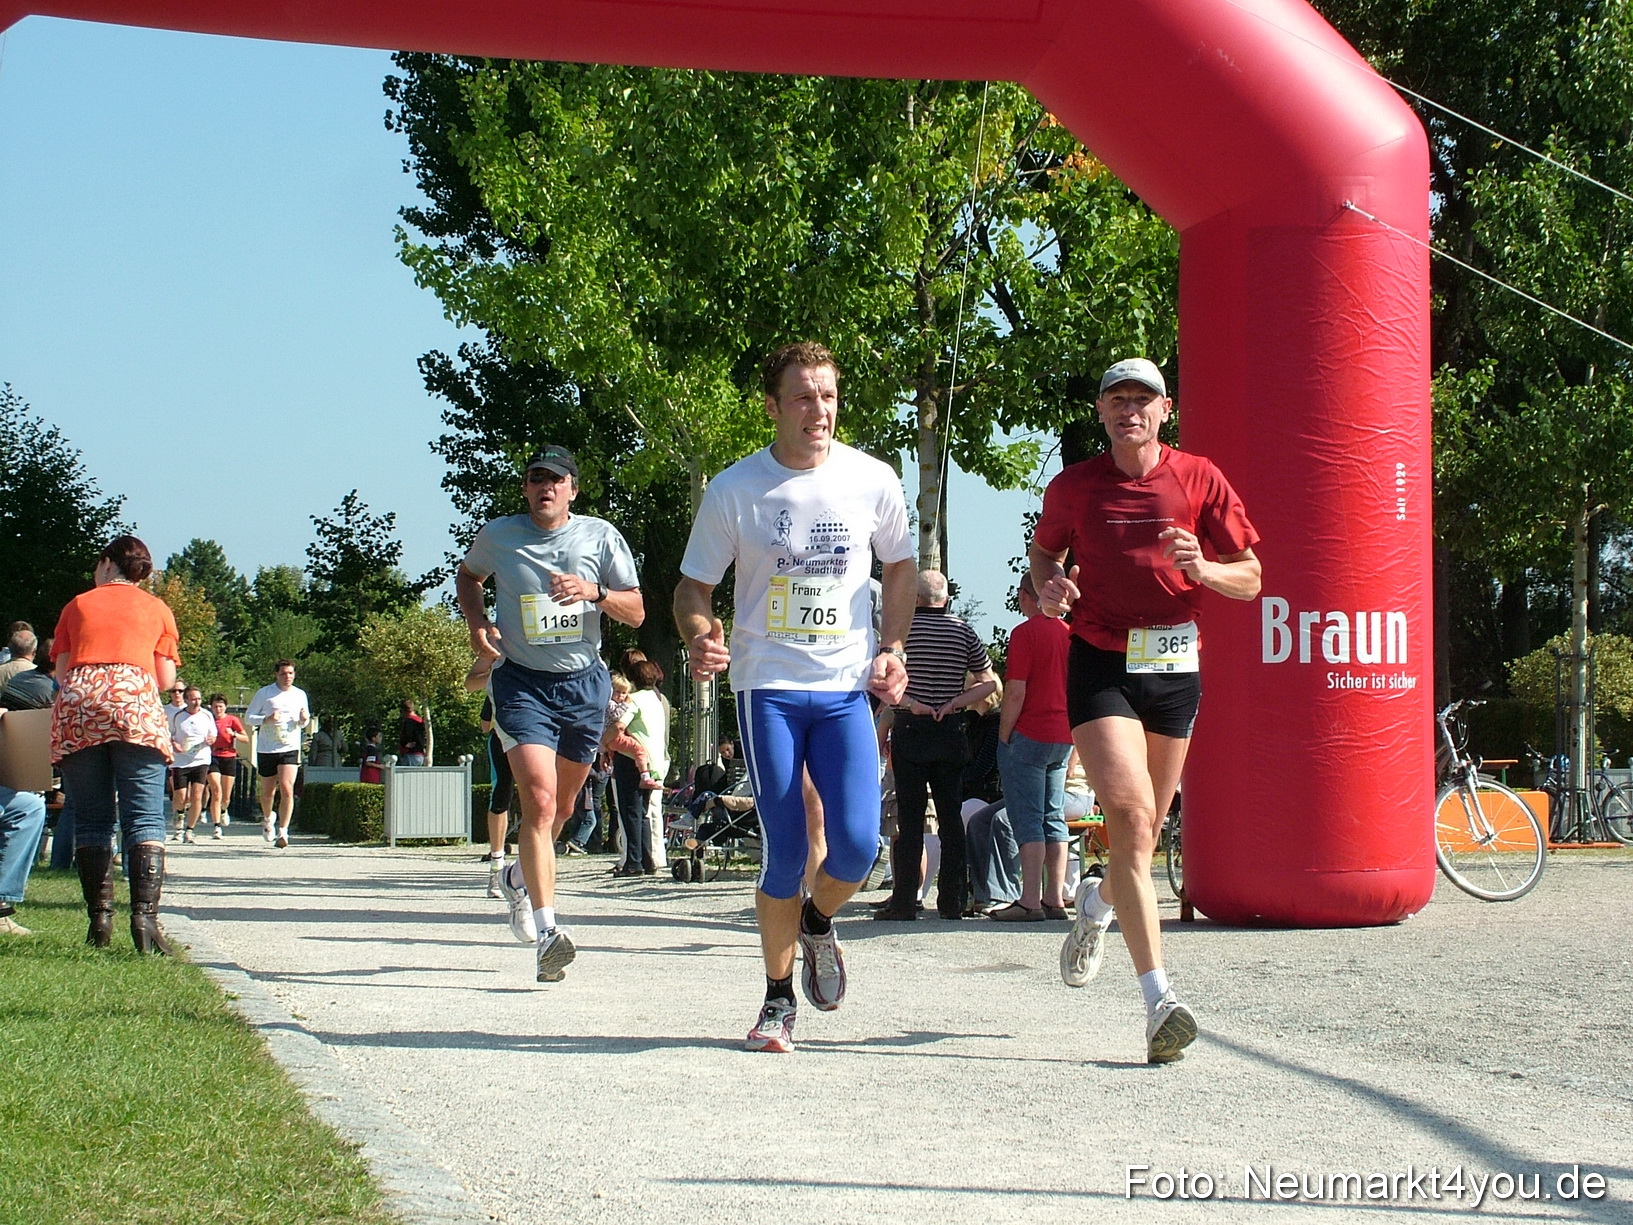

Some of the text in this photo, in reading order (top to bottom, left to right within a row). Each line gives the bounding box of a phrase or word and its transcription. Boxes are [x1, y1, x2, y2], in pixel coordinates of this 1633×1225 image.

[1396, 462, 1406, 520] Seit 1929
[809, 535, 851, 543] 16.09.2007
[792, 558, 848, 567] Neumarkter
[804, 566, 848, 575] Stadtlauf
[792, 583, 821, 597] Franz
[772, 600, 778, 610] C
[541, 614, 578, 628] 1163
[799, 606, 837, 625] 705
[1261, 596, 1408, 664] Braun
[1131, 633, 1137, 642] C
[1157, 635, 1189, 654] 365
[1327, 671, 1417, 689] Sicher ist sicher
